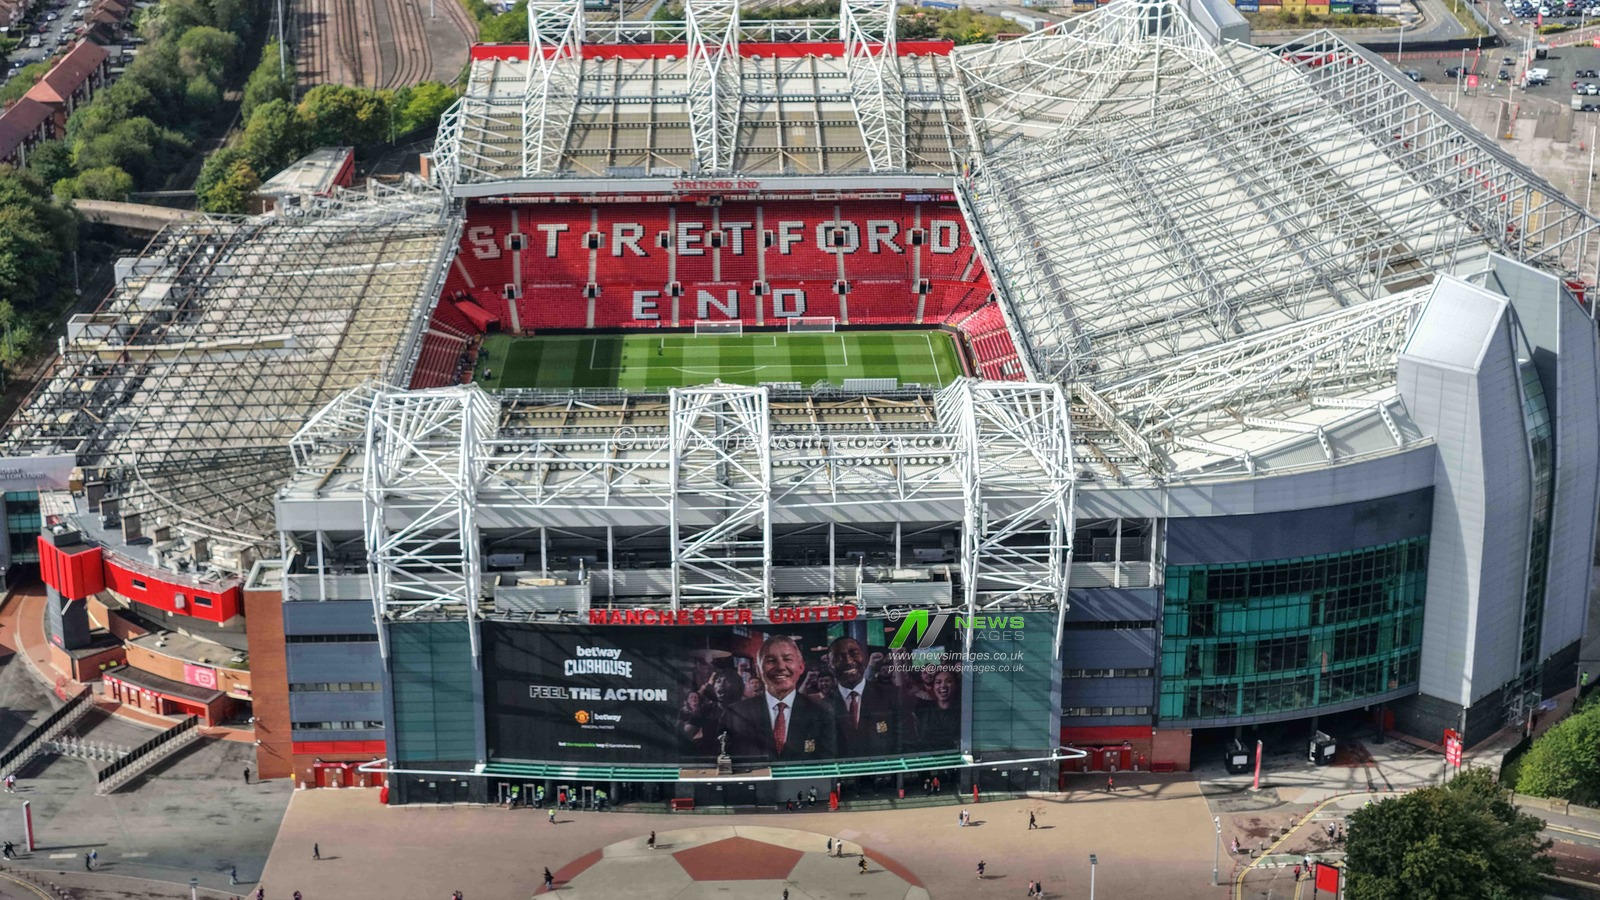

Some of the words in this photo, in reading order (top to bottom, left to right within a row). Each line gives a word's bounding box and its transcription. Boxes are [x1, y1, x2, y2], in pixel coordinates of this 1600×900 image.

[672, 181, 733, 190] STRETFORD
[737, 181, 759, 189] END
[468, 220, 960, 260] STRETFORD
[632, 289, 806, 320] END
[588, 608, 753, 625] MANCHESTER
[769, 604, 858, 624] UNITED
[576, 646, 622, 659] betway
[564, 659, 632, 678] CLUBHOUSE
[529, 685, 569, 700] FEEL
[569, 687, 602, 700] THE
[603, 688, 667, 701] ACTION
[594, 713, 622, 722] betway
